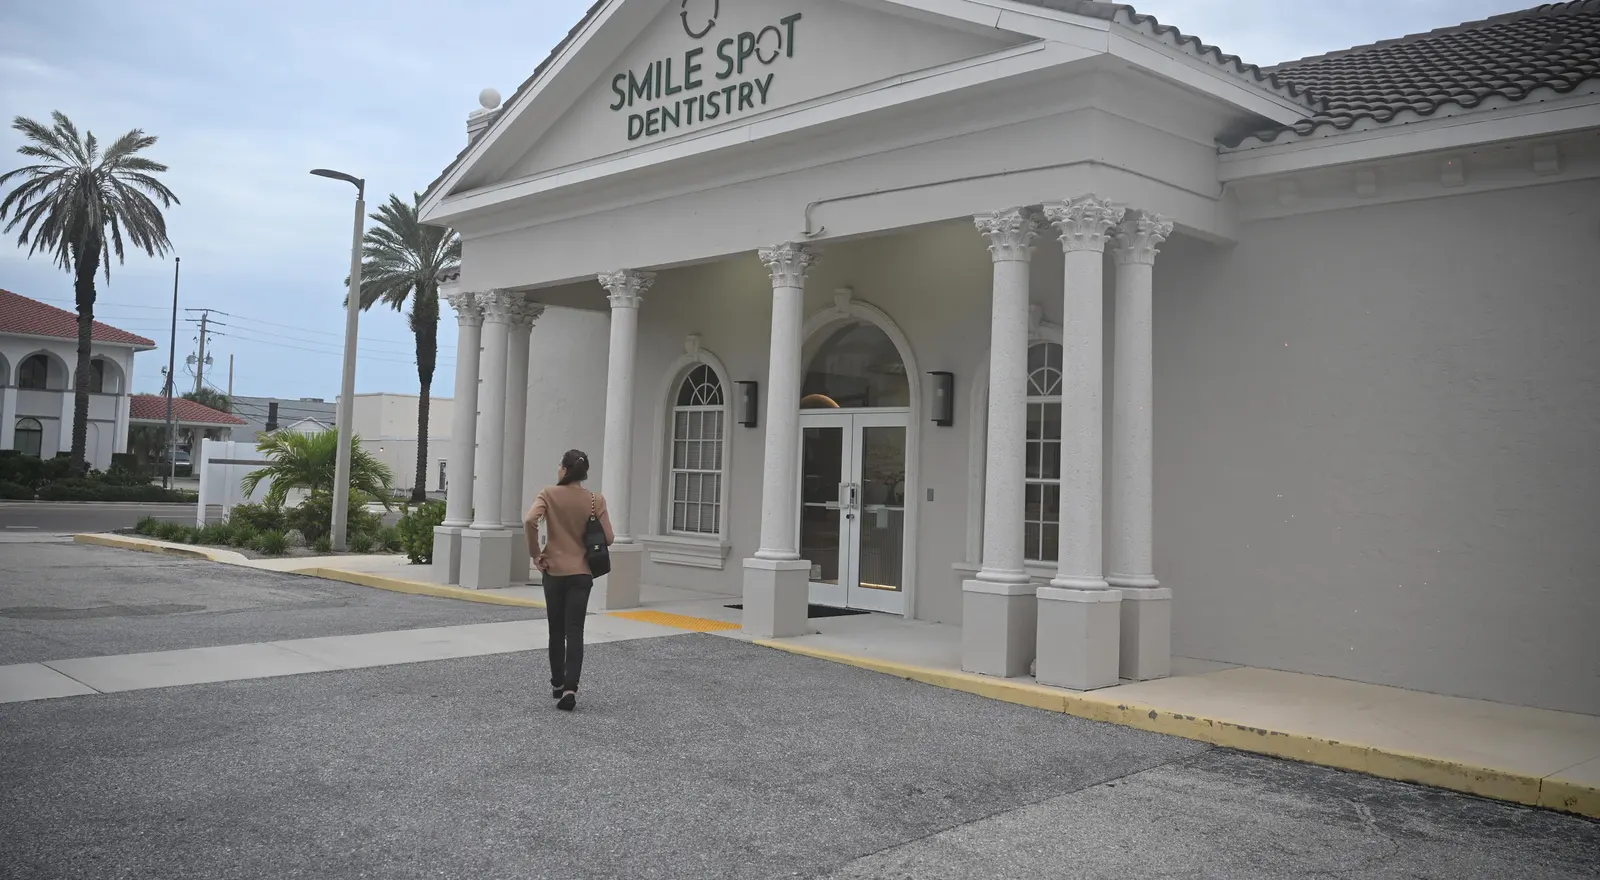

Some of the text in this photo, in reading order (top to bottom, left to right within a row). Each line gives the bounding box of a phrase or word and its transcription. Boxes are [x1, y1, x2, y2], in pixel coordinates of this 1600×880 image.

[610, 13, 802, 111] SMILE SPOT
[627, 73, 774, 141] DENTISTRY
